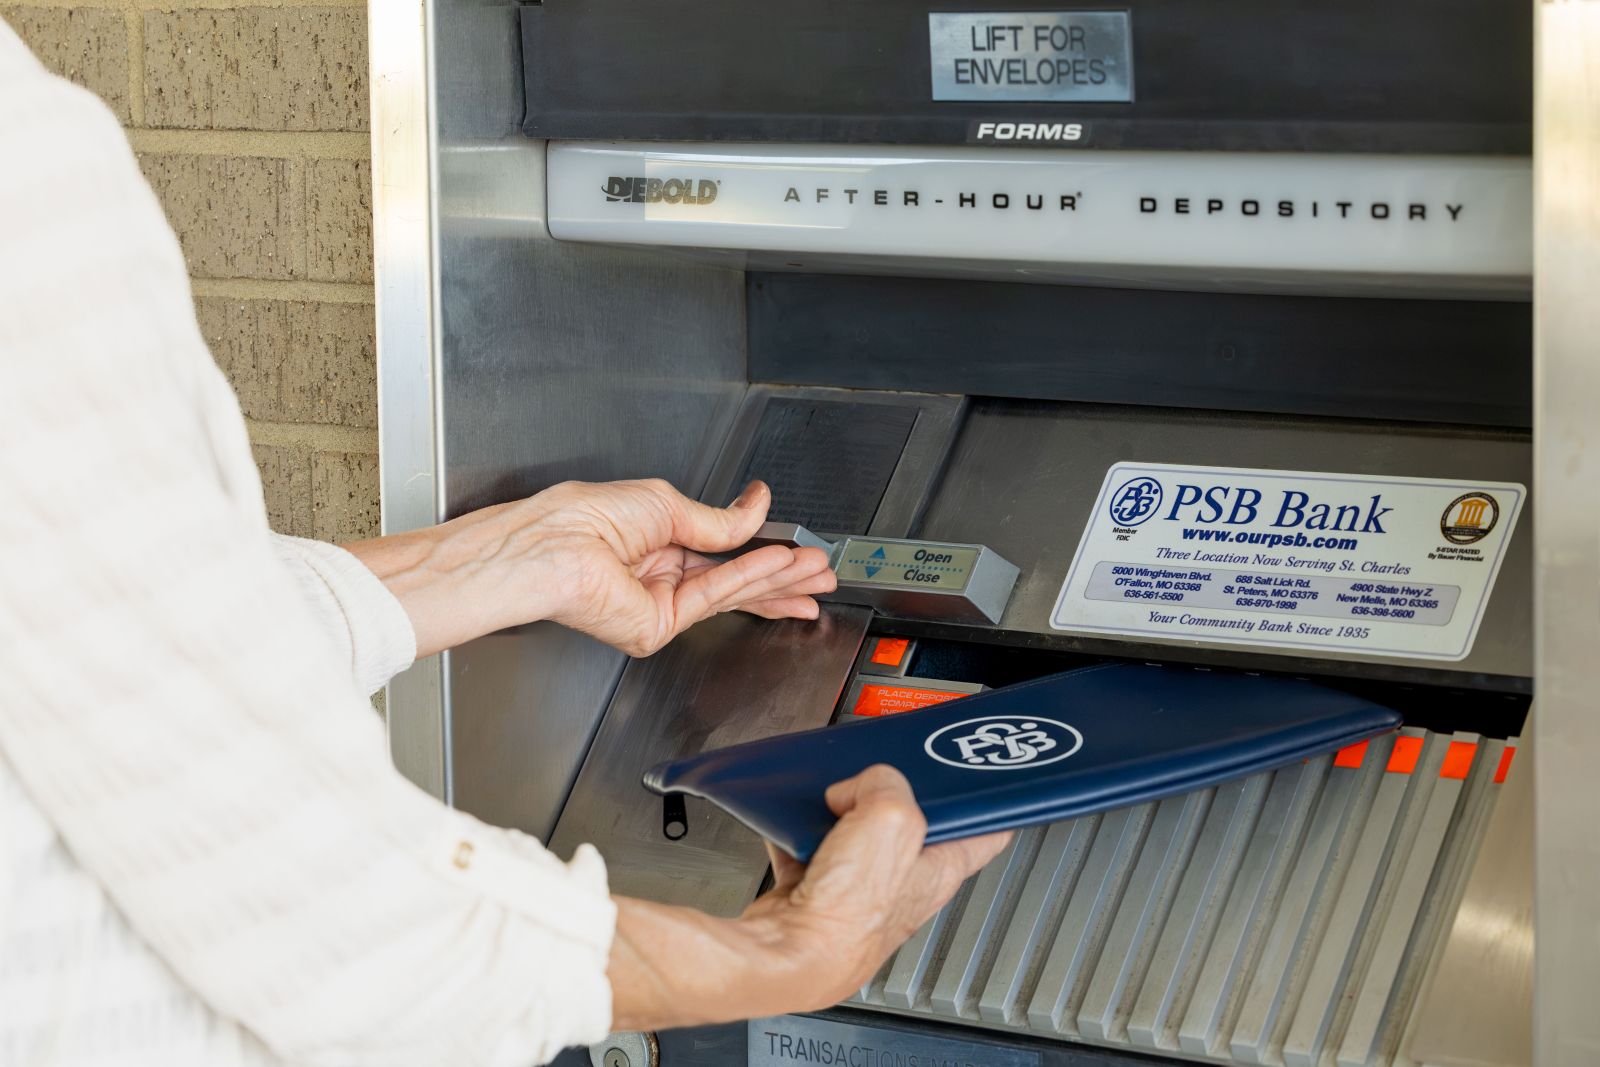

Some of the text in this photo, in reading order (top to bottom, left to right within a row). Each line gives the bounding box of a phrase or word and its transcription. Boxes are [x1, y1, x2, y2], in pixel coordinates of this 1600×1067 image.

[971, 26, 1086, 51] LIFT FOR
[954, 59, 1107, 85] ENVELOPES
[977, 123, 1083, 141] FORMS
[601, 176, 718, 205] DIEBOLD
[784, 187, 1463, 221] AFTER-HOUR DEPOSITORY
[1164, 484, 1263, 525] PSB
[1270, 490, 1394, 534] Bank
[1182, 528, 1358, 550] www.ourpsb.com
[914, 549, 953, 564] Open
[1156, 548, 1411, 575] Three Location Now Serving St. Charles
[903, 568, 941, 583] Close
[1111, 566, 1212, 581] 5000 WingHaven Blvd.
[1115, 577, 1202, 592] O'Fallon, MO 63368
[1235, 575, 1311, 588] 688 Salt Lick Rd.
[1124, 590, 1184, 601] 636-561-5500
[1223, 585, 1319, 600] St. Peters, MO 63376
[1350, 583, 1433, 598] 4900 State Hwy Z
[1236, 598, 1297, 609] 636-970-1998
[1336, 593, 1358, 603] New
[1389, 597, 1408, 607] MO
[1409, 599, 1439, 609] 63365
[1351, 606, 1415, 618] 636-398-5600
[1148, 611, 1371, 639] Your Community Bank Since 1935
[878, 689, 913, 699] PLACE
[880, 699, 932, 709] COMPLE
